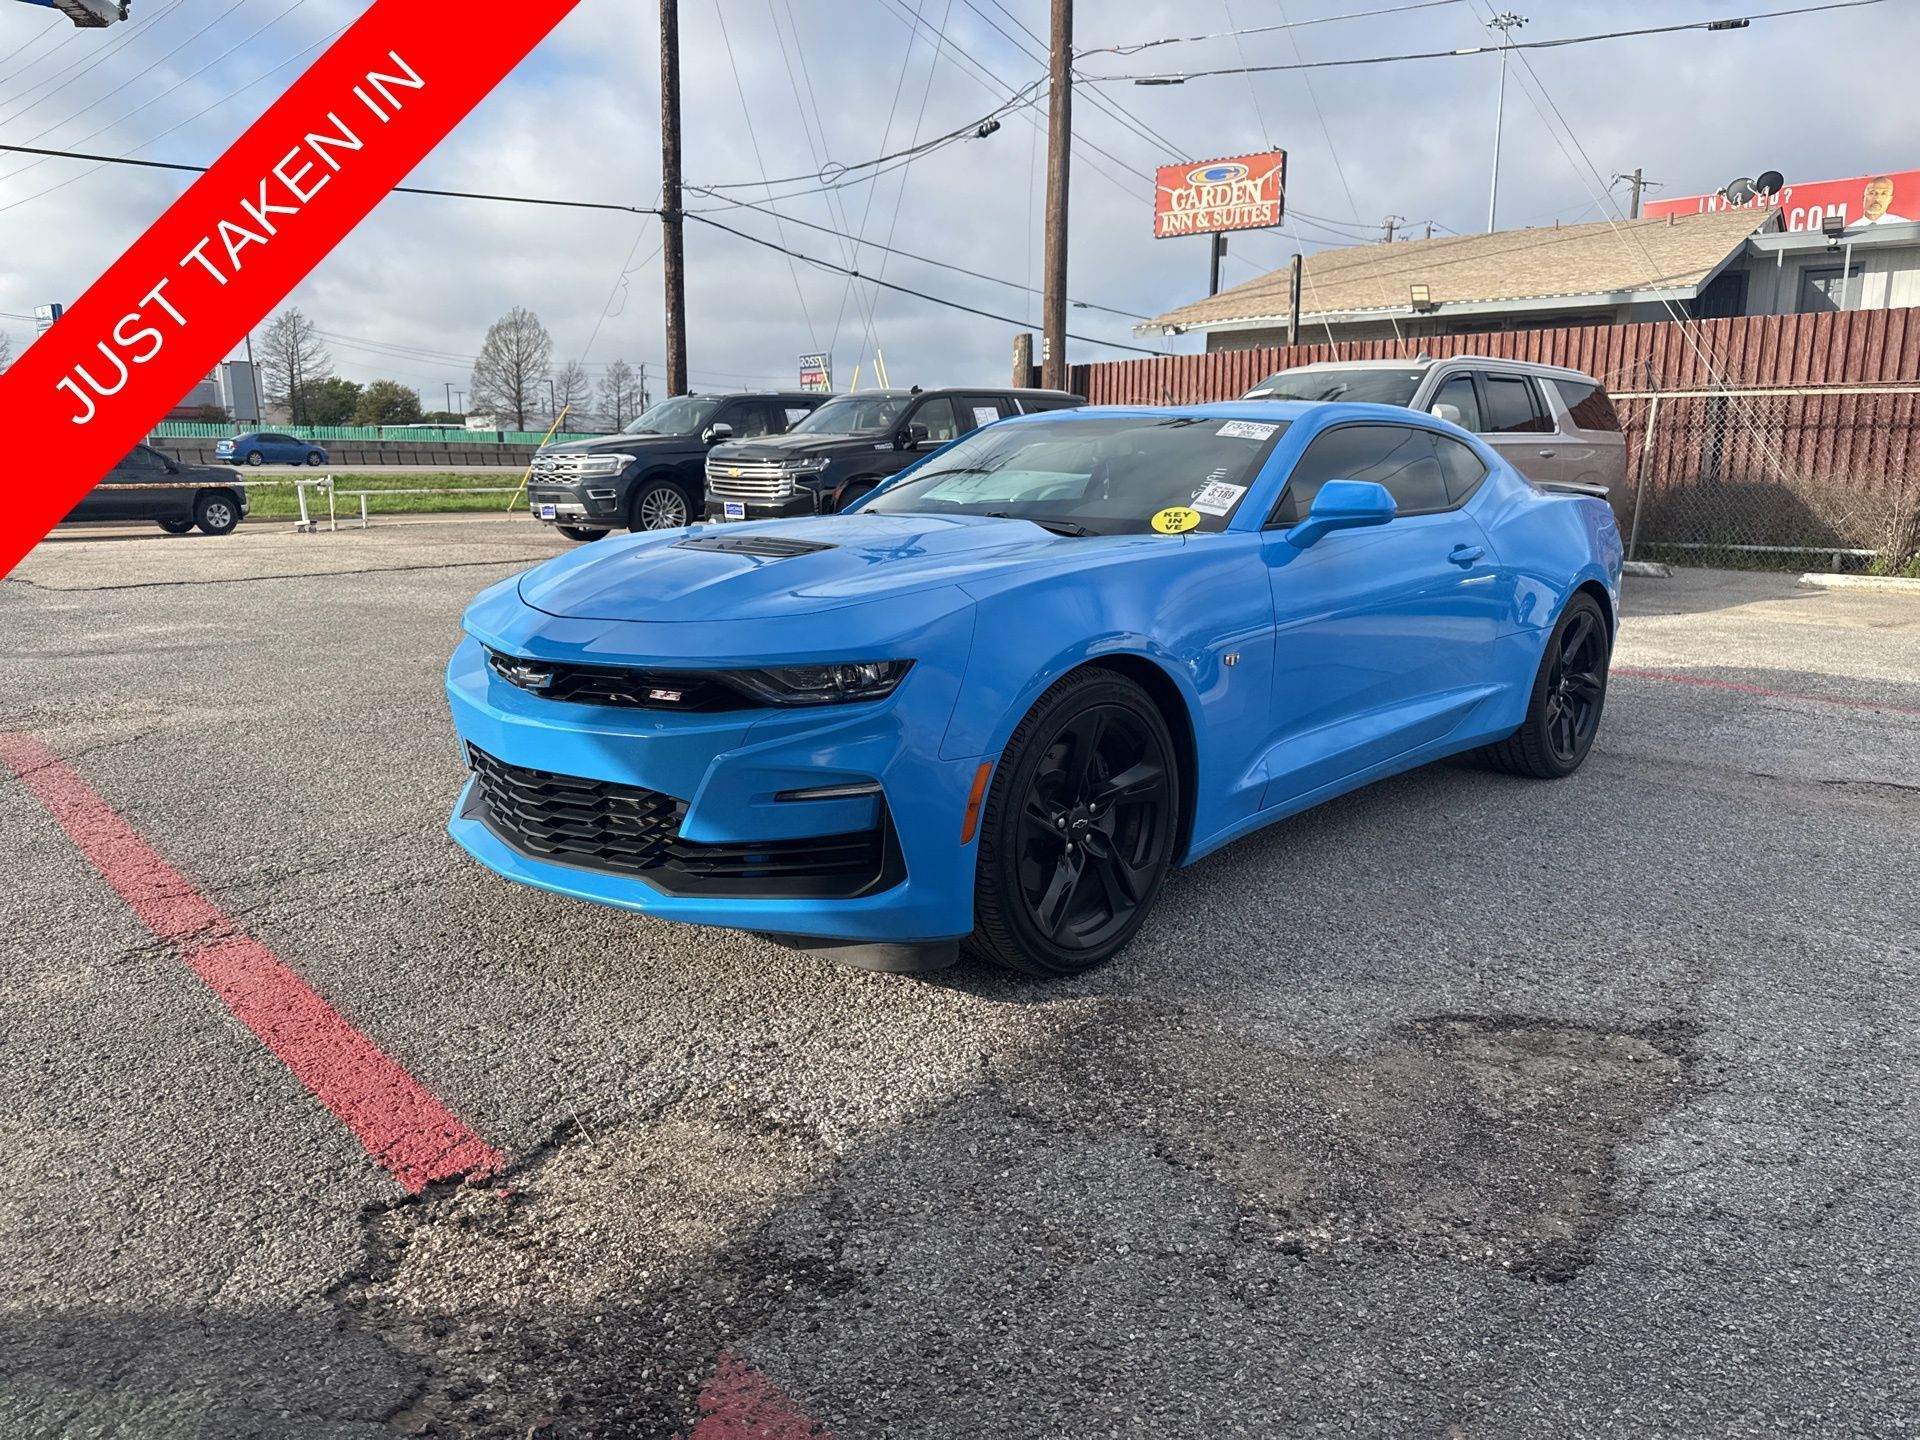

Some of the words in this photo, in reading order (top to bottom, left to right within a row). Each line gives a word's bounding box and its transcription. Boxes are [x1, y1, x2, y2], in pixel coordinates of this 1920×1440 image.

[1171, 179, 1262, 212] GARDEN
[1161, 212, 1194, 233] INN
[1196, 210, 1210, 228] &
[1213, 205, 1271, 227] SUITES
